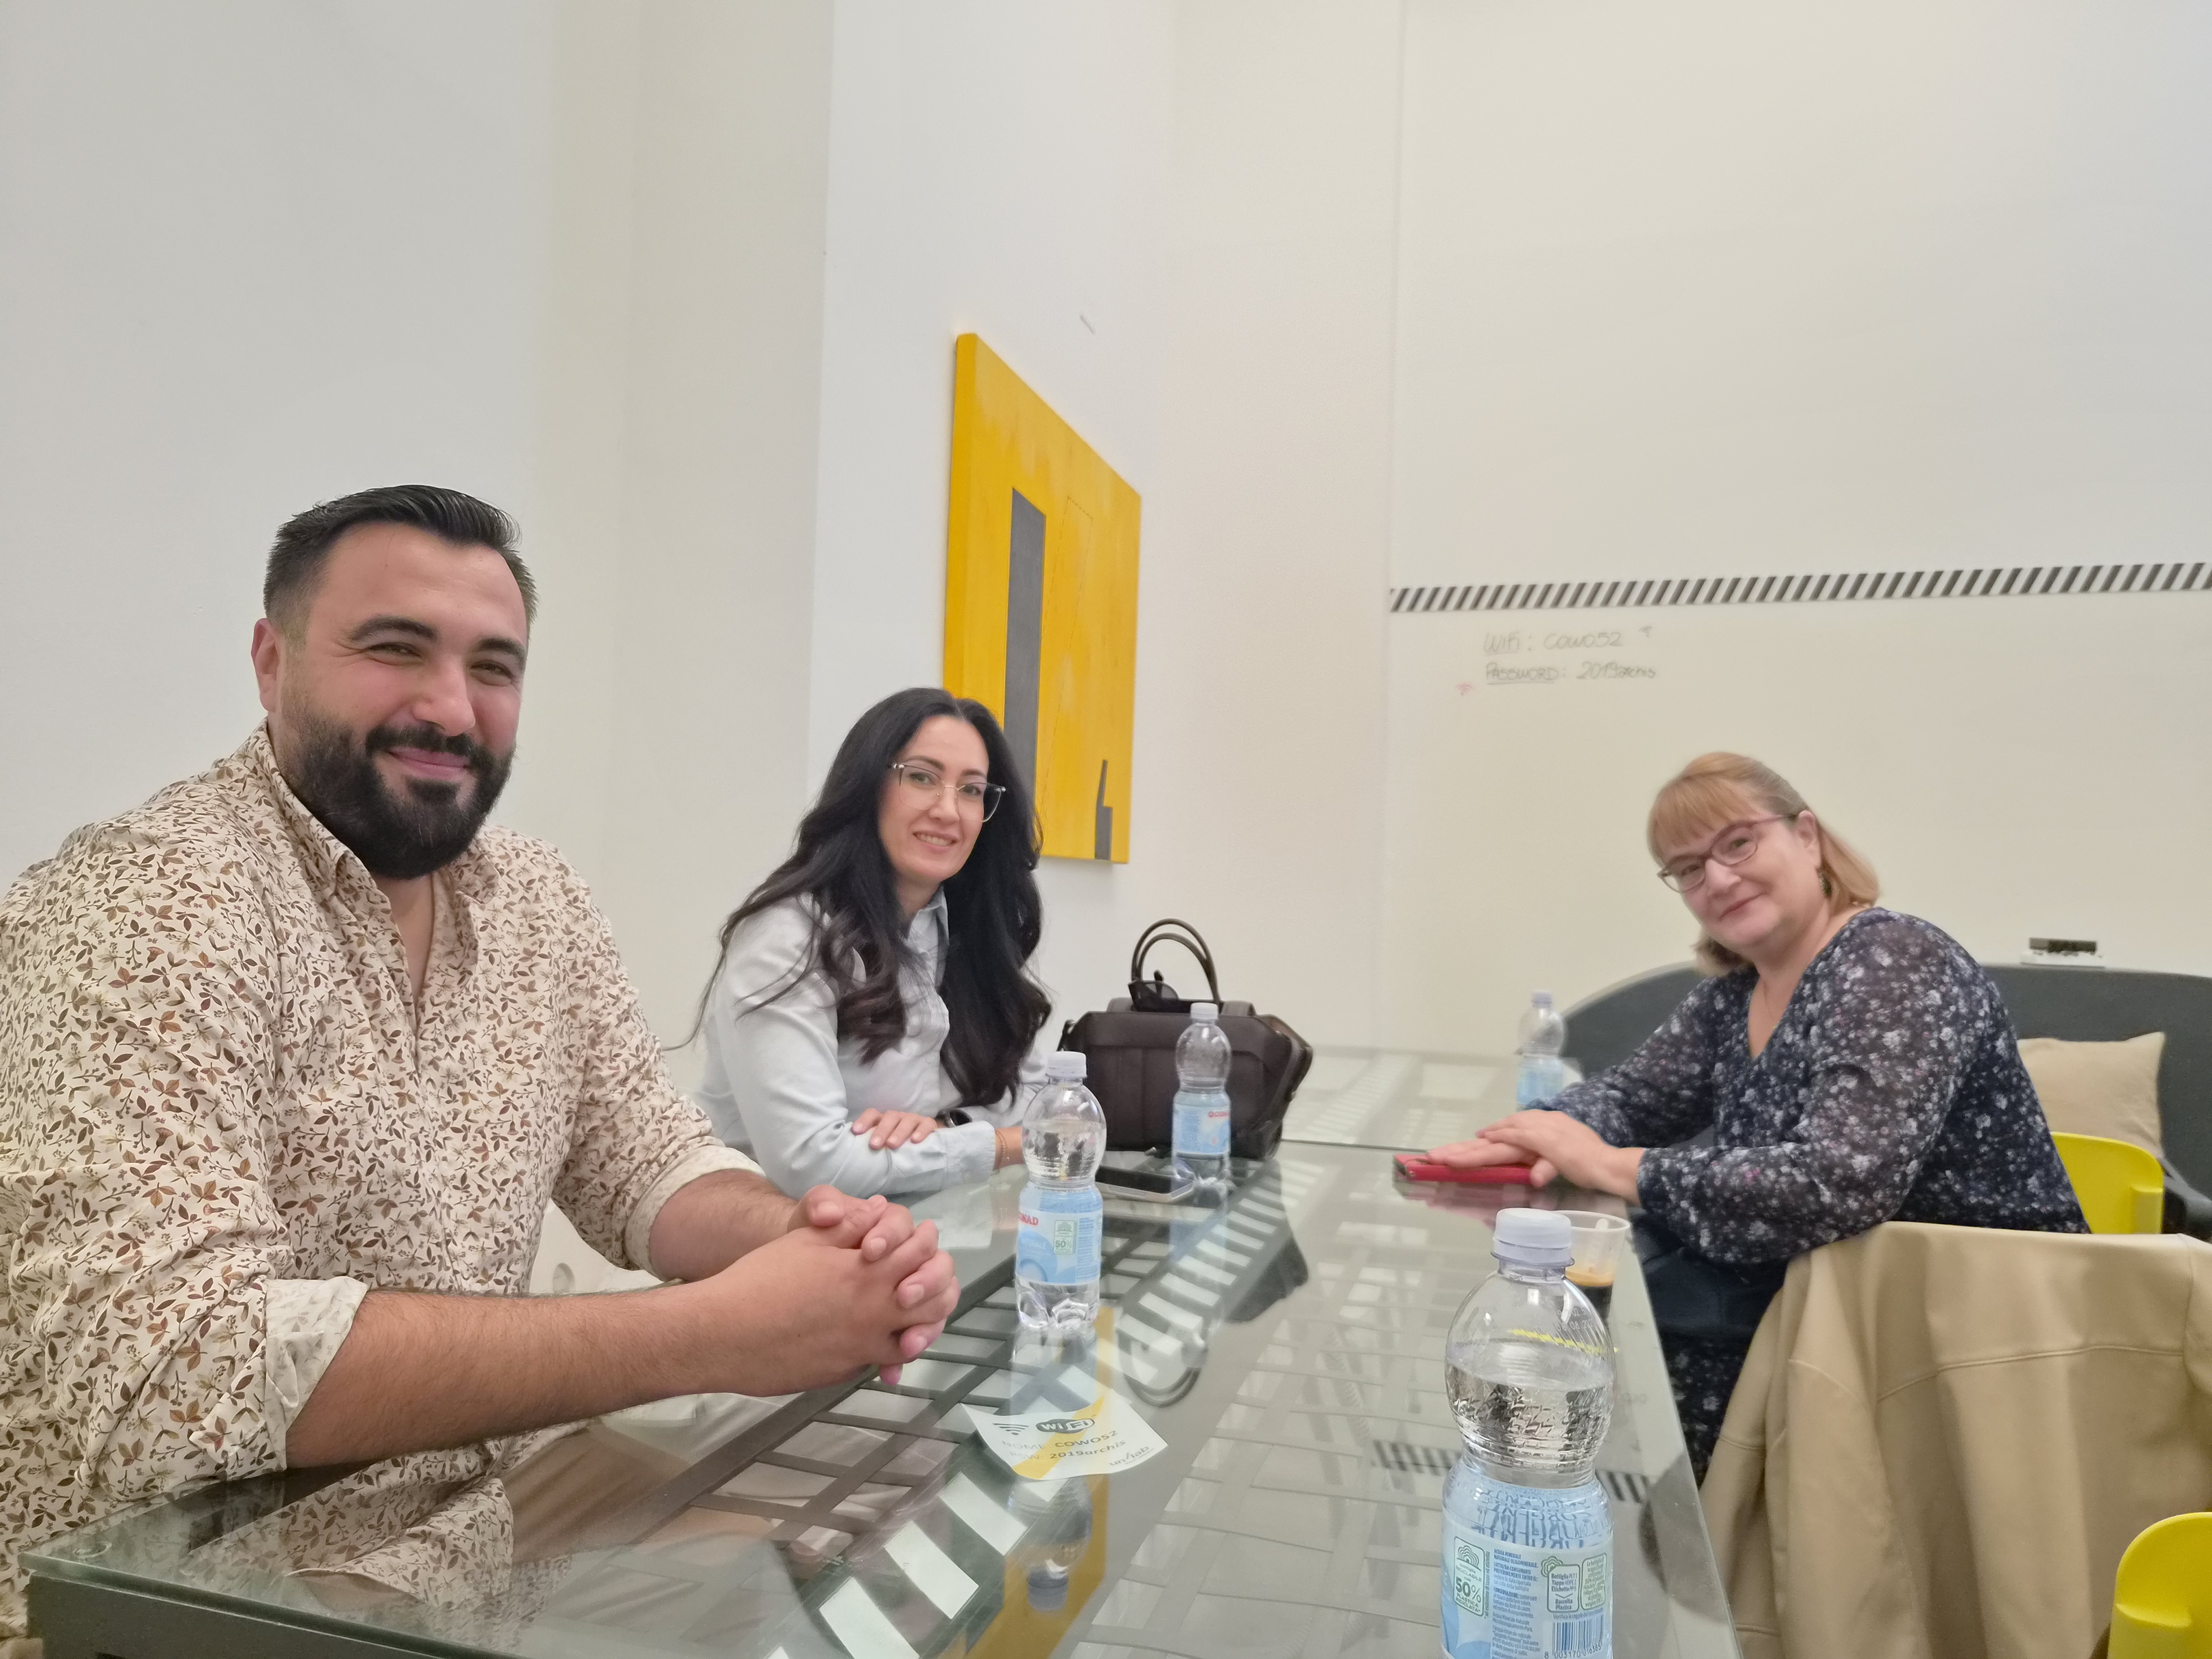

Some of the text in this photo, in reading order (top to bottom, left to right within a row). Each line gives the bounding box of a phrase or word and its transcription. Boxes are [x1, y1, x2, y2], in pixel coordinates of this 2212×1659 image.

[1002, 1430, 1118, 1449] NOME: COWO52
[1050, 1439, 1126, 1459] 2019archis
[1455, 1576, 1481, 1603] 50%
[1457, 1592, 1479, 1608] PLASTICA
